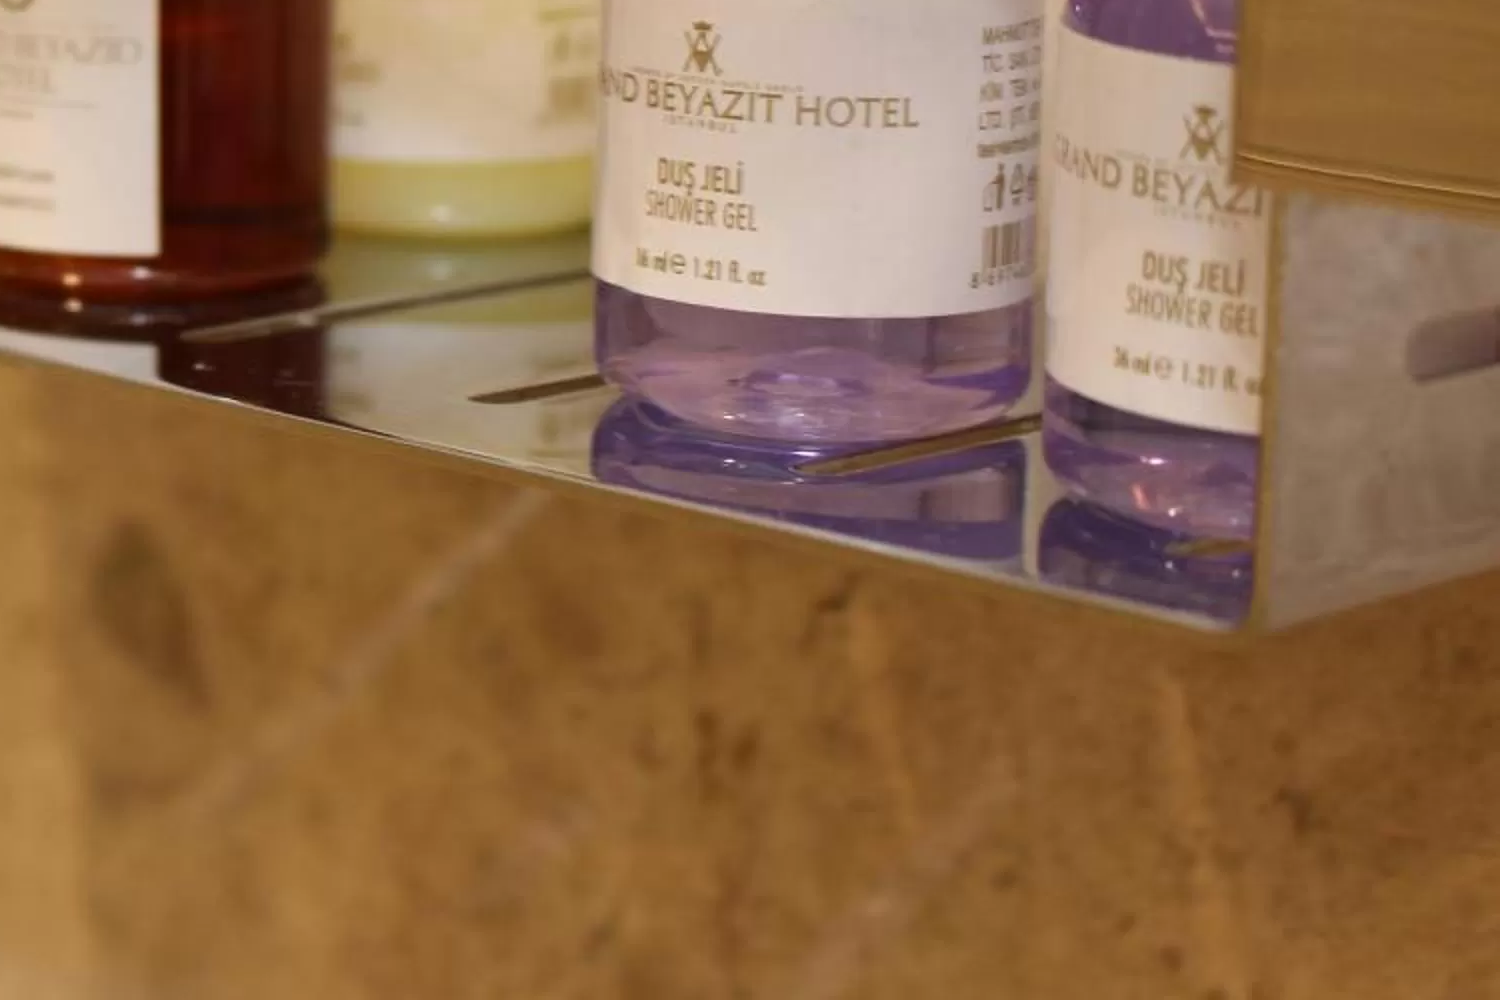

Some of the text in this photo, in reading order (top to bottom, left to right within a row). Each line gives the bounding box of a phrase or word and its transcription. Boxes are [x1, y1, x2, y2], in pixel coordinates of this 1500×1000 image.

[647, 79, 783, 123] BEYAZIT
[796, 95, 920, 129] HOTEL
[657, 157, 746, 197] DUŞ JELİ
[645, 189, 758, 232] SHOWER GEL
[1141, 249, 1189, 294] DUŞ
[1125, 281, 1258, 338] SHOWER GEL
